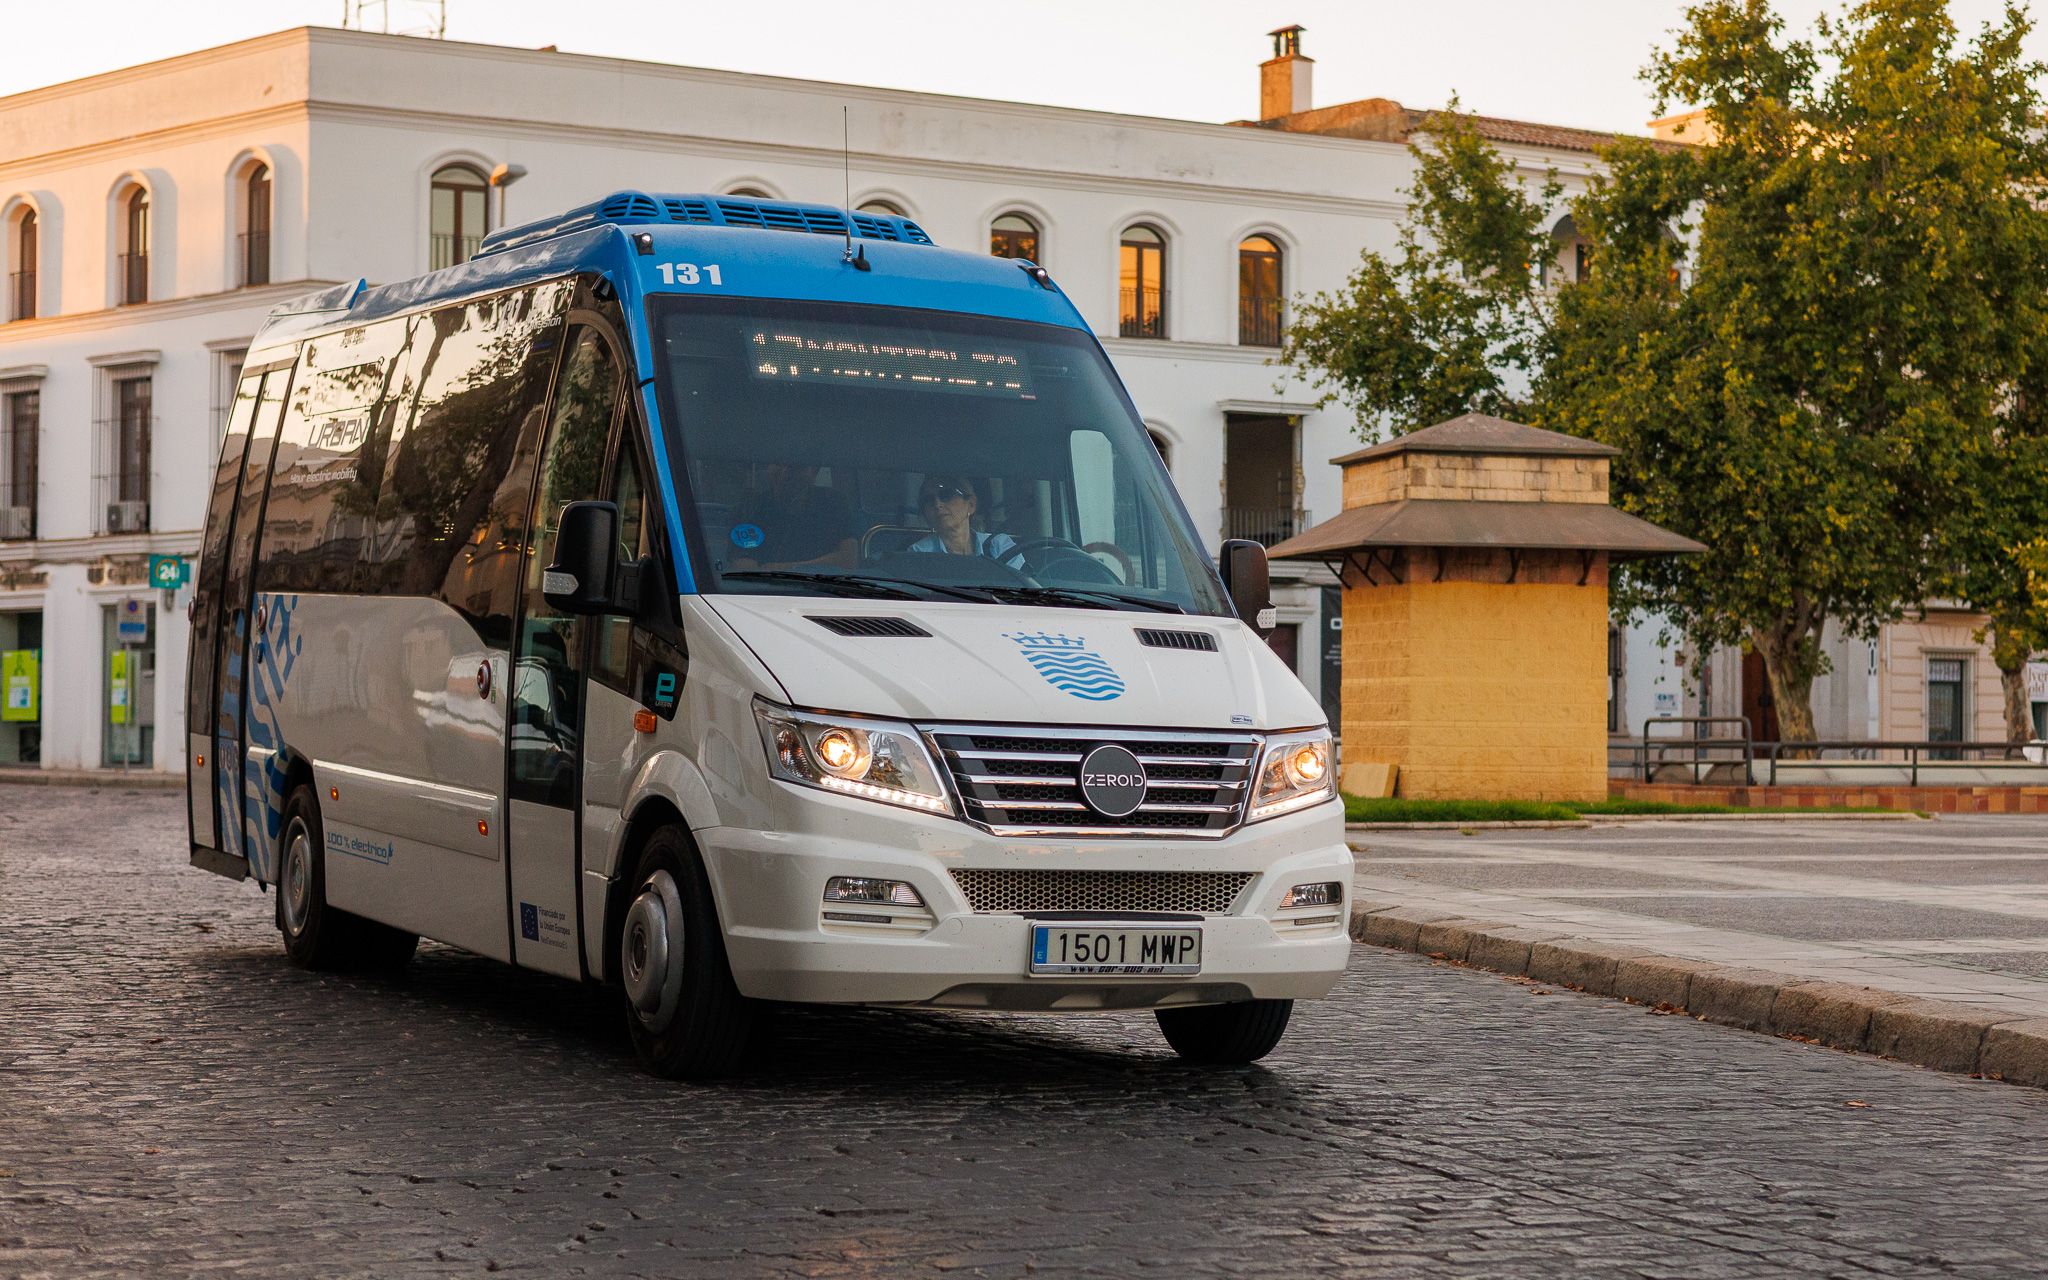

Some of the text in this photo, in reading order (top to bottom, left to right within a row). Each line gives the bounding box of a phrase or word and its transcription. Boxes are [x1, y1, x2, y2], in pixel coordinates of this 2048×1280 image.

[656, 263, 722, 285] 131
[308, 417, 370, 448] URBAN
[1084, 774, 1144, 787] ZEROID
[327, 831, 343, 847] 100
[1037, 951, 1044, 960] E
[1059, 933, 1195, 964] 1501 MWP
